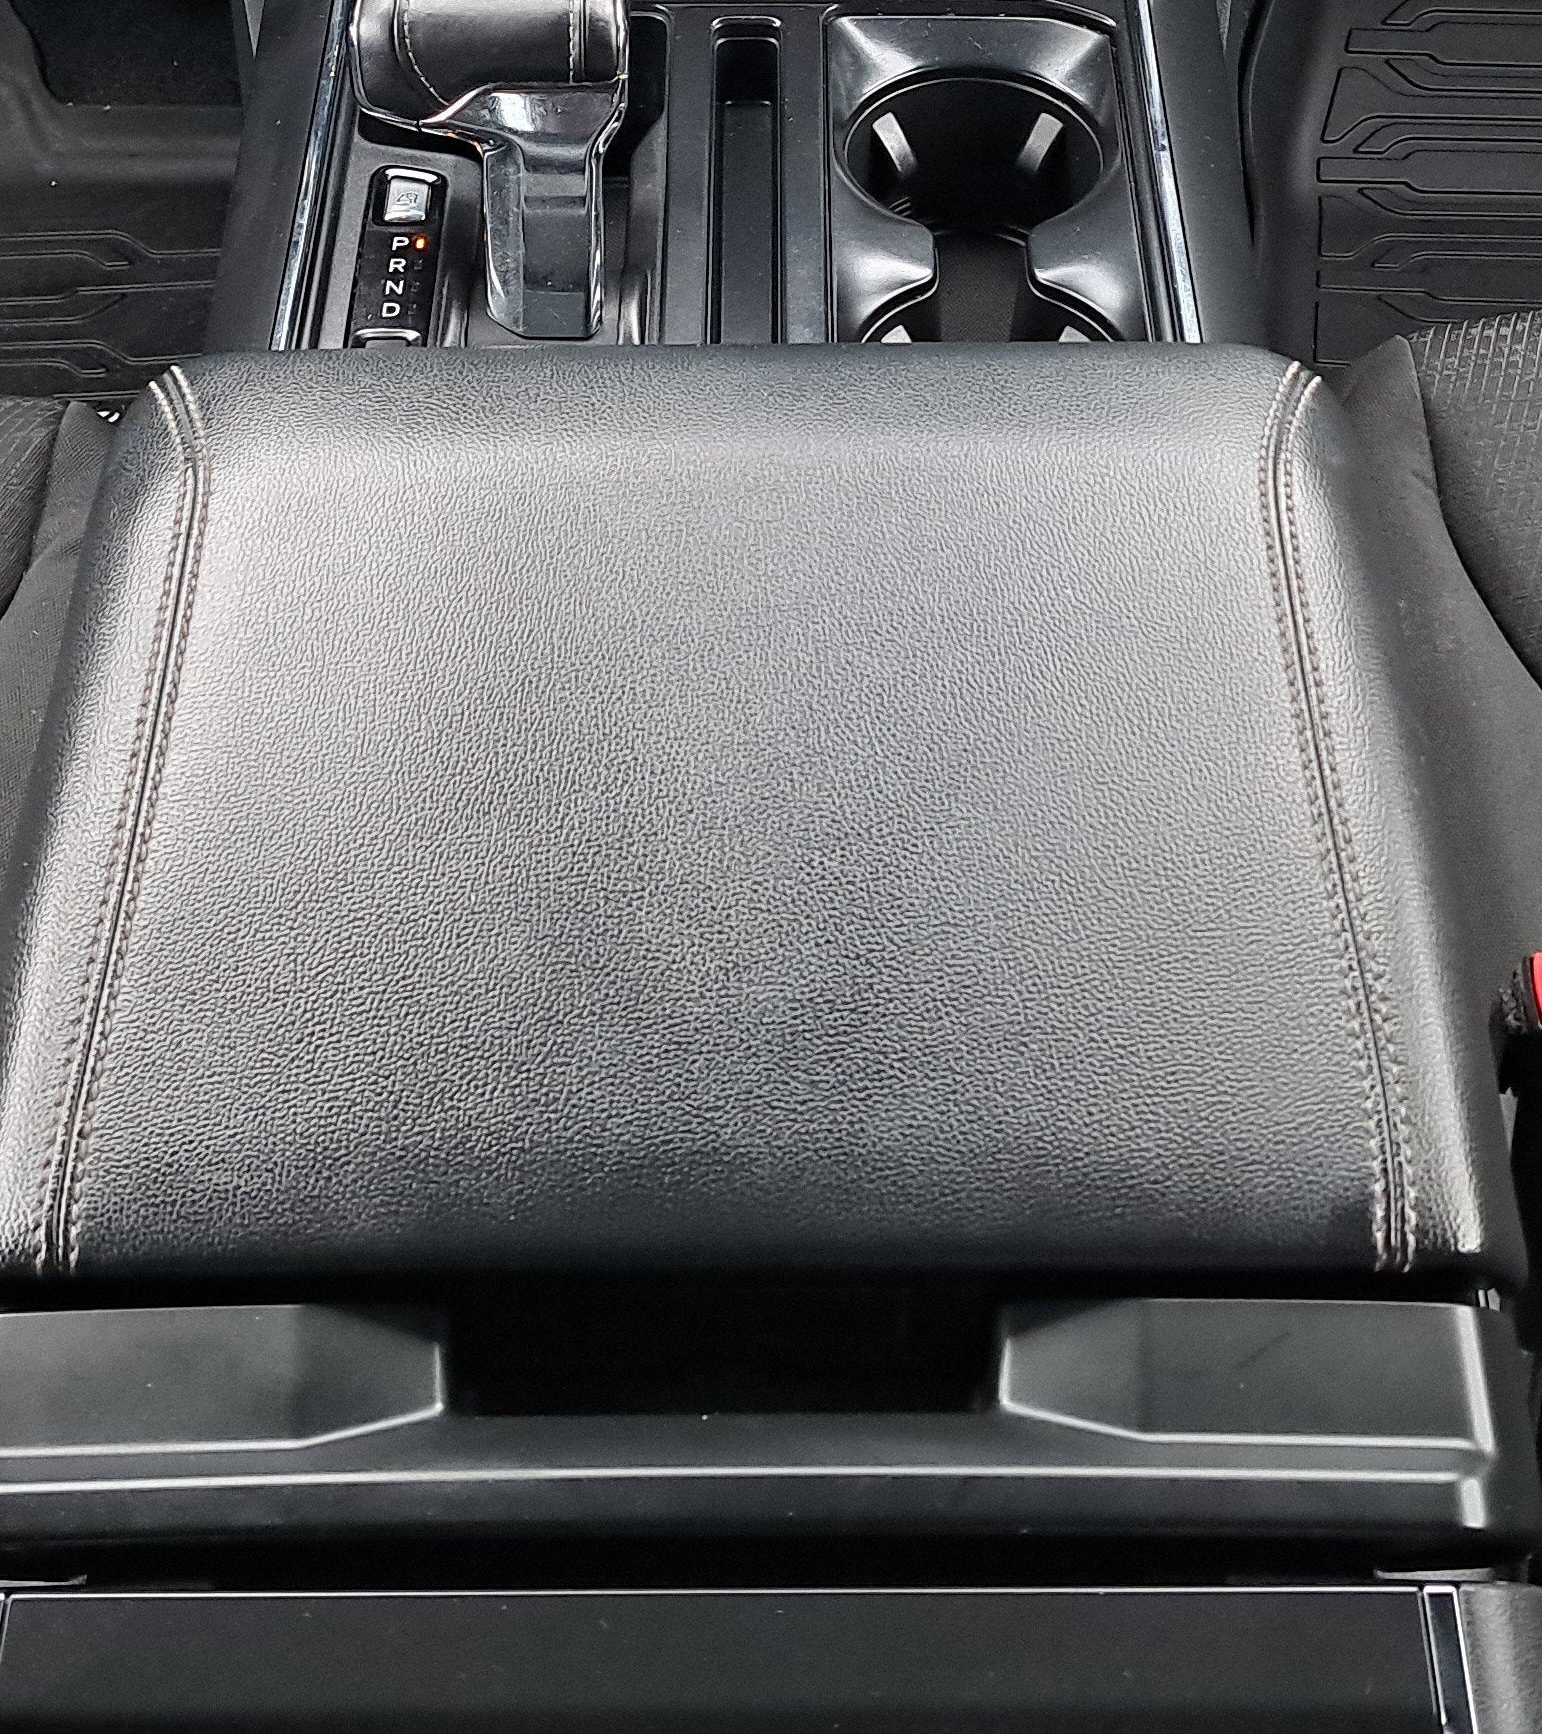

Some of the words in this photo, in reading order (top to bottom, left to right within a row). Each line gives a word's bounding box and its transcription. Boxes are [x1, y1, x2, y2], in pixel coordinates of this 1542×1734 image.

[391, 236, 410, 251] P
[388, 257, 407, 273] R
[385, 280, 404, 296] N
[381, 302, 401, 318] D
